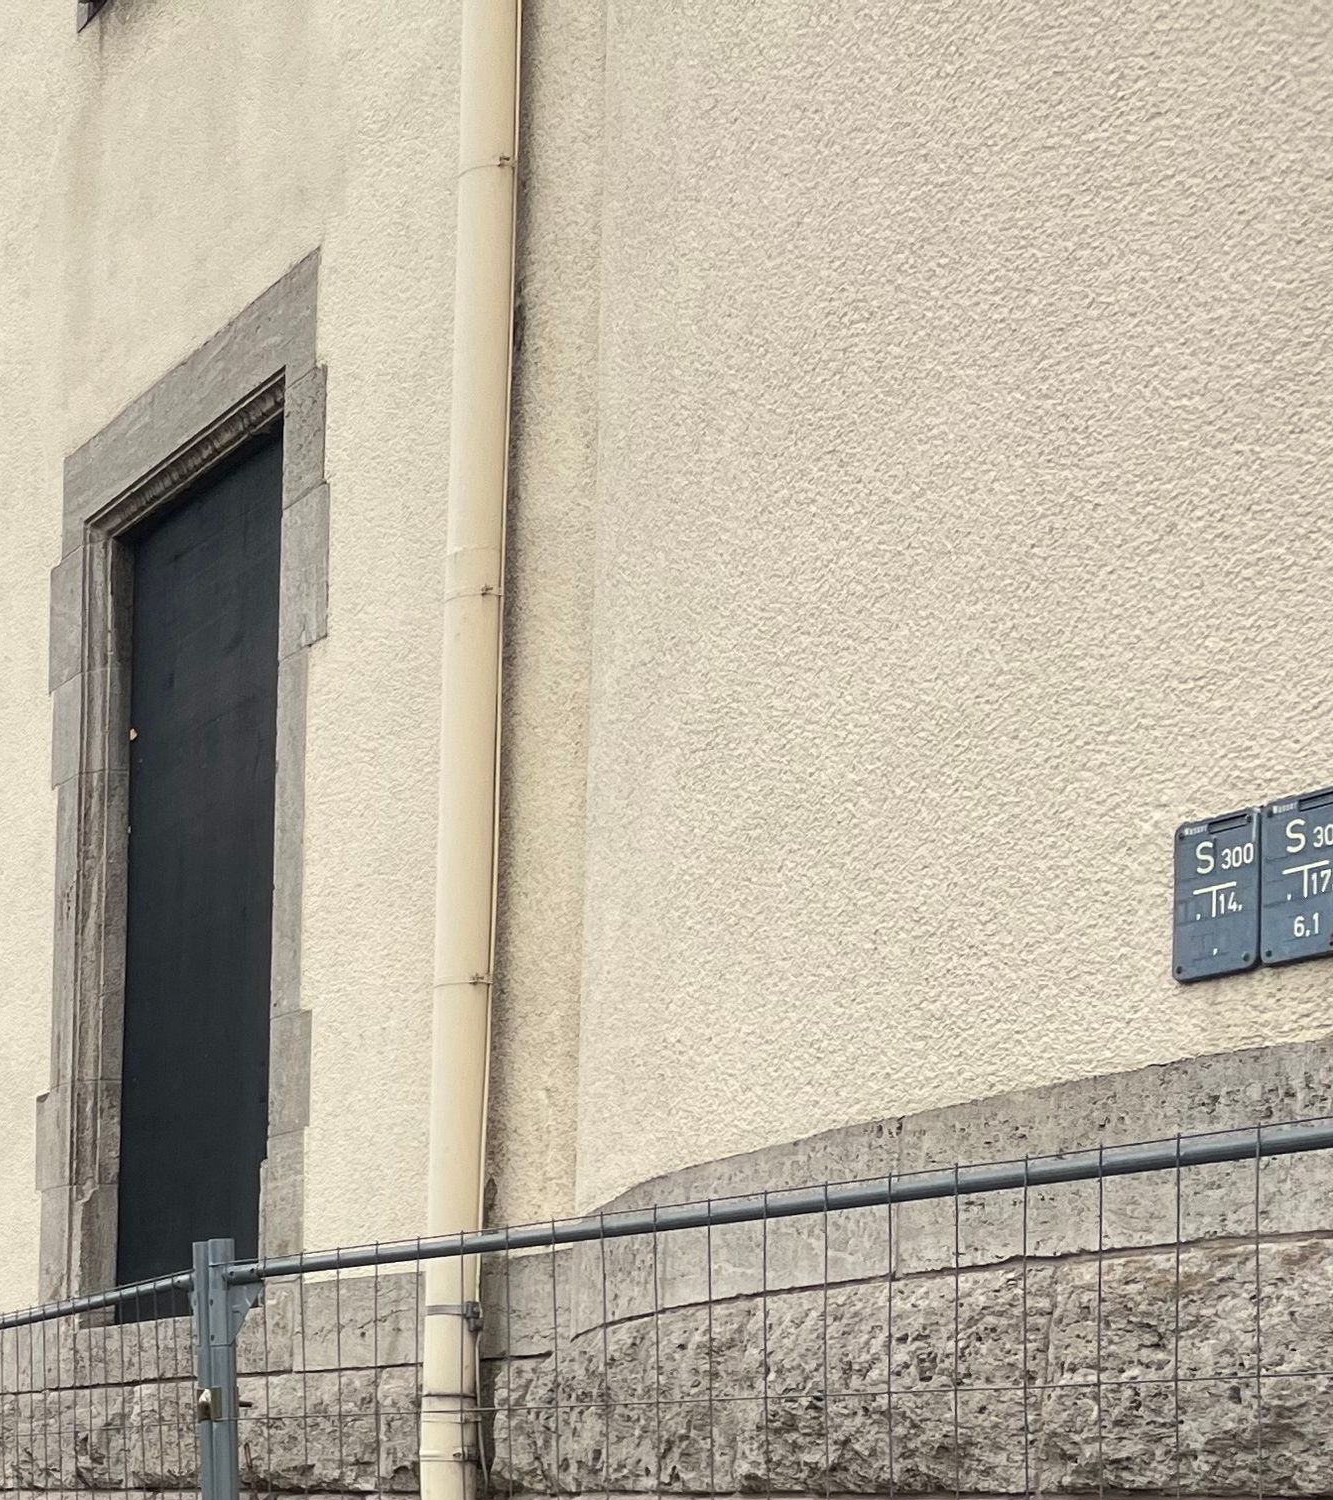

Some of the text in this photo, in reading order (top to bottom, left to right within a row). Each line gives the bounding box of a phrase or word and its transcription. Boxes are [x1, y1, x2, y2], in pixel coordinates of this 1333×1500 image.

[1286, 819, 1306, 853] S
[1196, 841, 1254, 874] S 300
[1293, 912, 1319, 937] 6,1
